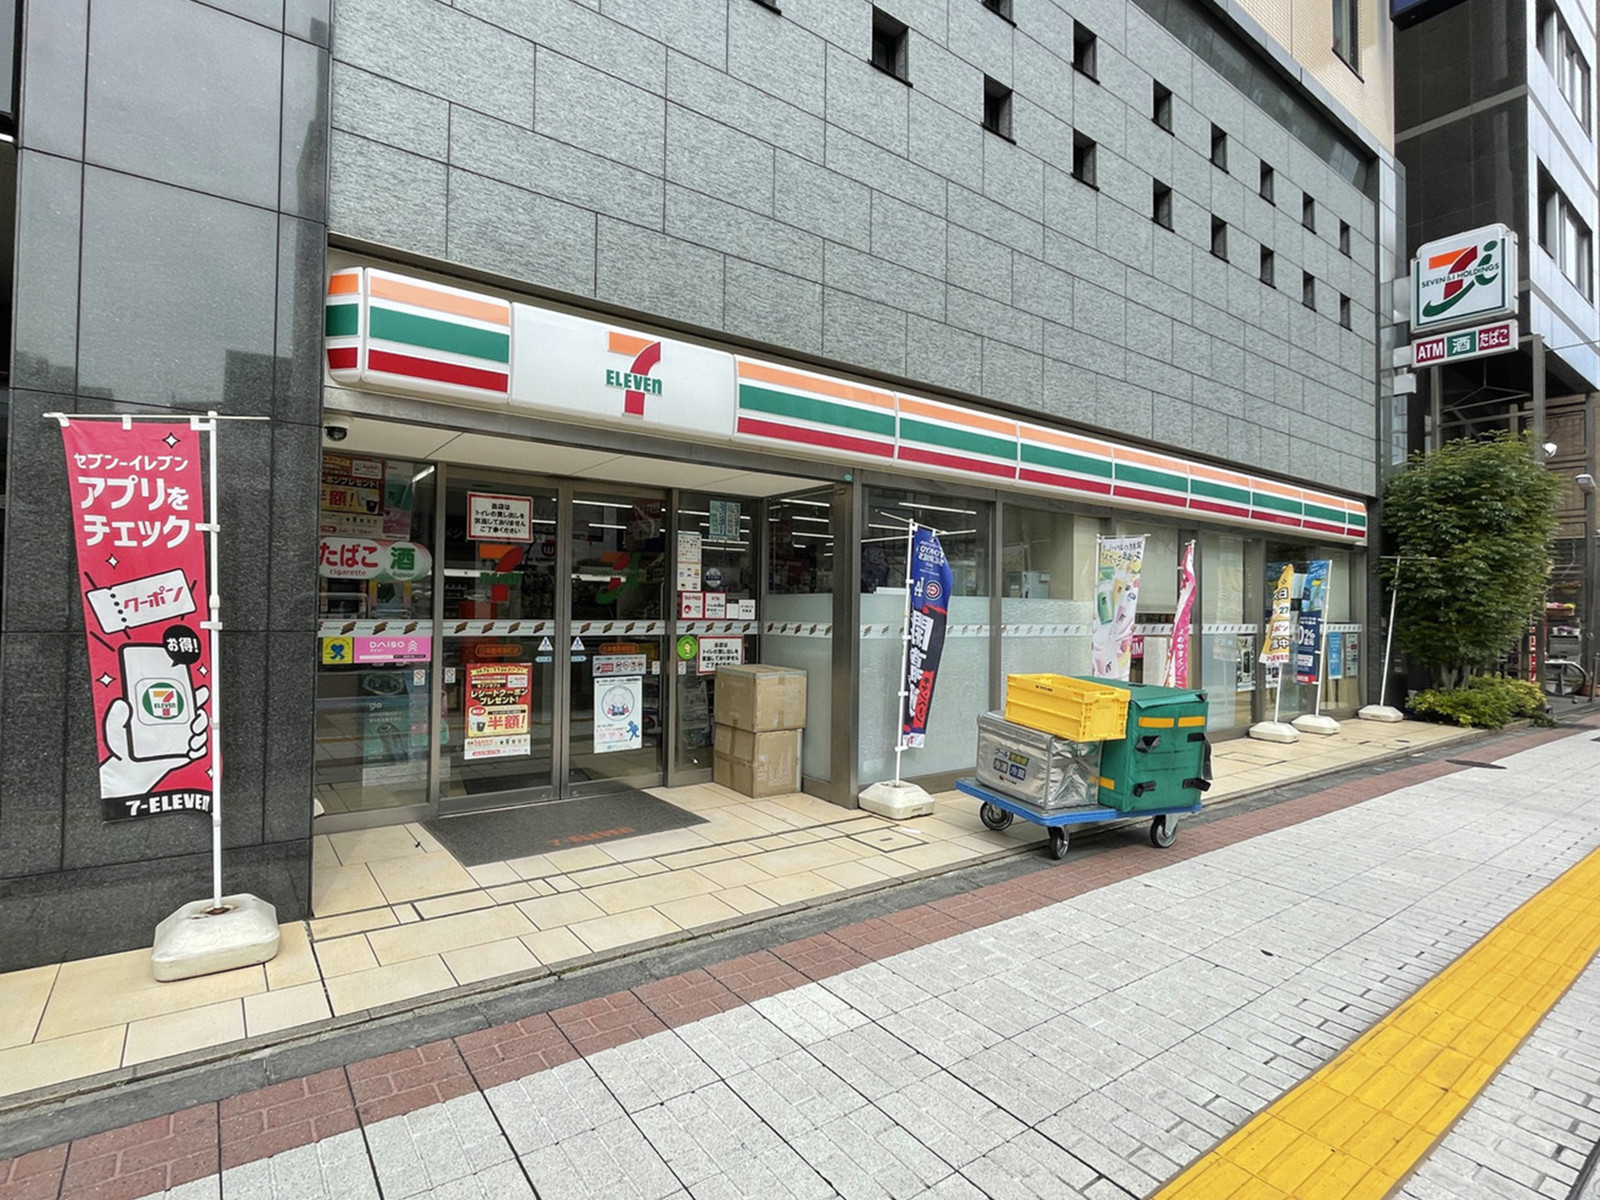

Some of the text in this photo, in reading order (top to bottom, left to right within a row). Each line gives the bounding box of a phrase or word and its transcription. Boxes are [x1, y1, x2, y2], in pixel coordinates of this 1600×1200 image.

[1457, 263, 1500, 279] HOLDINGS
[1417, 329, 1509, 360] ATM 酒 たばこ
[77, 474, 190, 511] アプリを
[83, 514, 192, 548] チェック
[480, 526, 521, 535] ご了承ください
[319, 543, 415, 571] たばこ 酒
[123, 585, 184, 614] クーポン
[166, 636, 200, 654] お得!
[369, 641, 405, 649] DAISO
[470, 688, 528, 698] レシートクーポン
[480, 696, 519, 705] プレゼント!
[487, 715, 526, 730] 半額!
